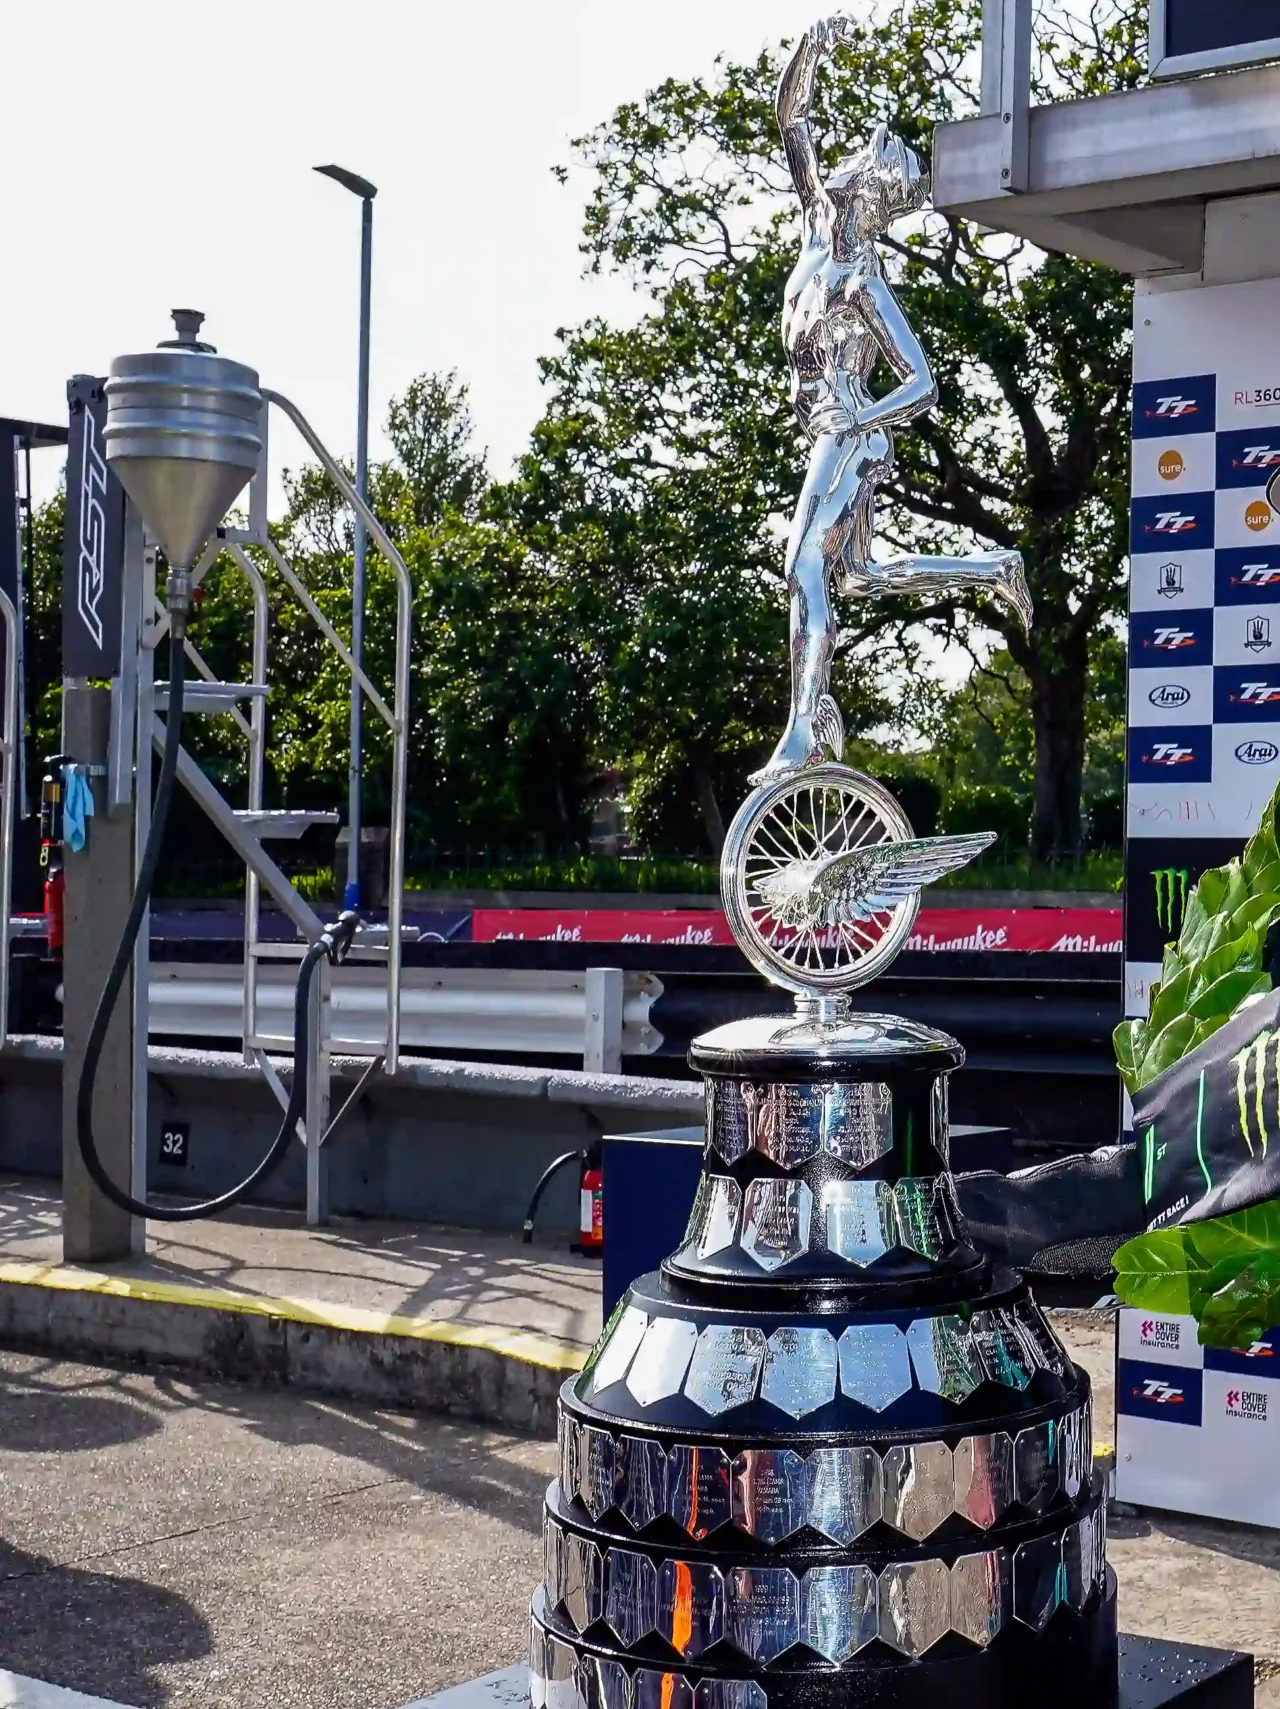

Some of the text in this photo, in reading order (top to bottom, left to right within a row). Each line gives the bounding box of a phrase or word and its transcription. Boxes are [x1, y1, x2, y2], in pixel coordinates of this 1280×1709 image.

[163, 1131, 184, 1155] 32
[1155, 1321, 1180, 1333] ENTIRE
[1155, 1331, 1180, 1342] COVER
[1140, 1337, 1180, 1350] insurance
[1241, 1392, 1268, 1404] ENTIRE
[1241, 1401, 1267, 1413] COVER
[1226, 1407, 1267, 1421] insurance
